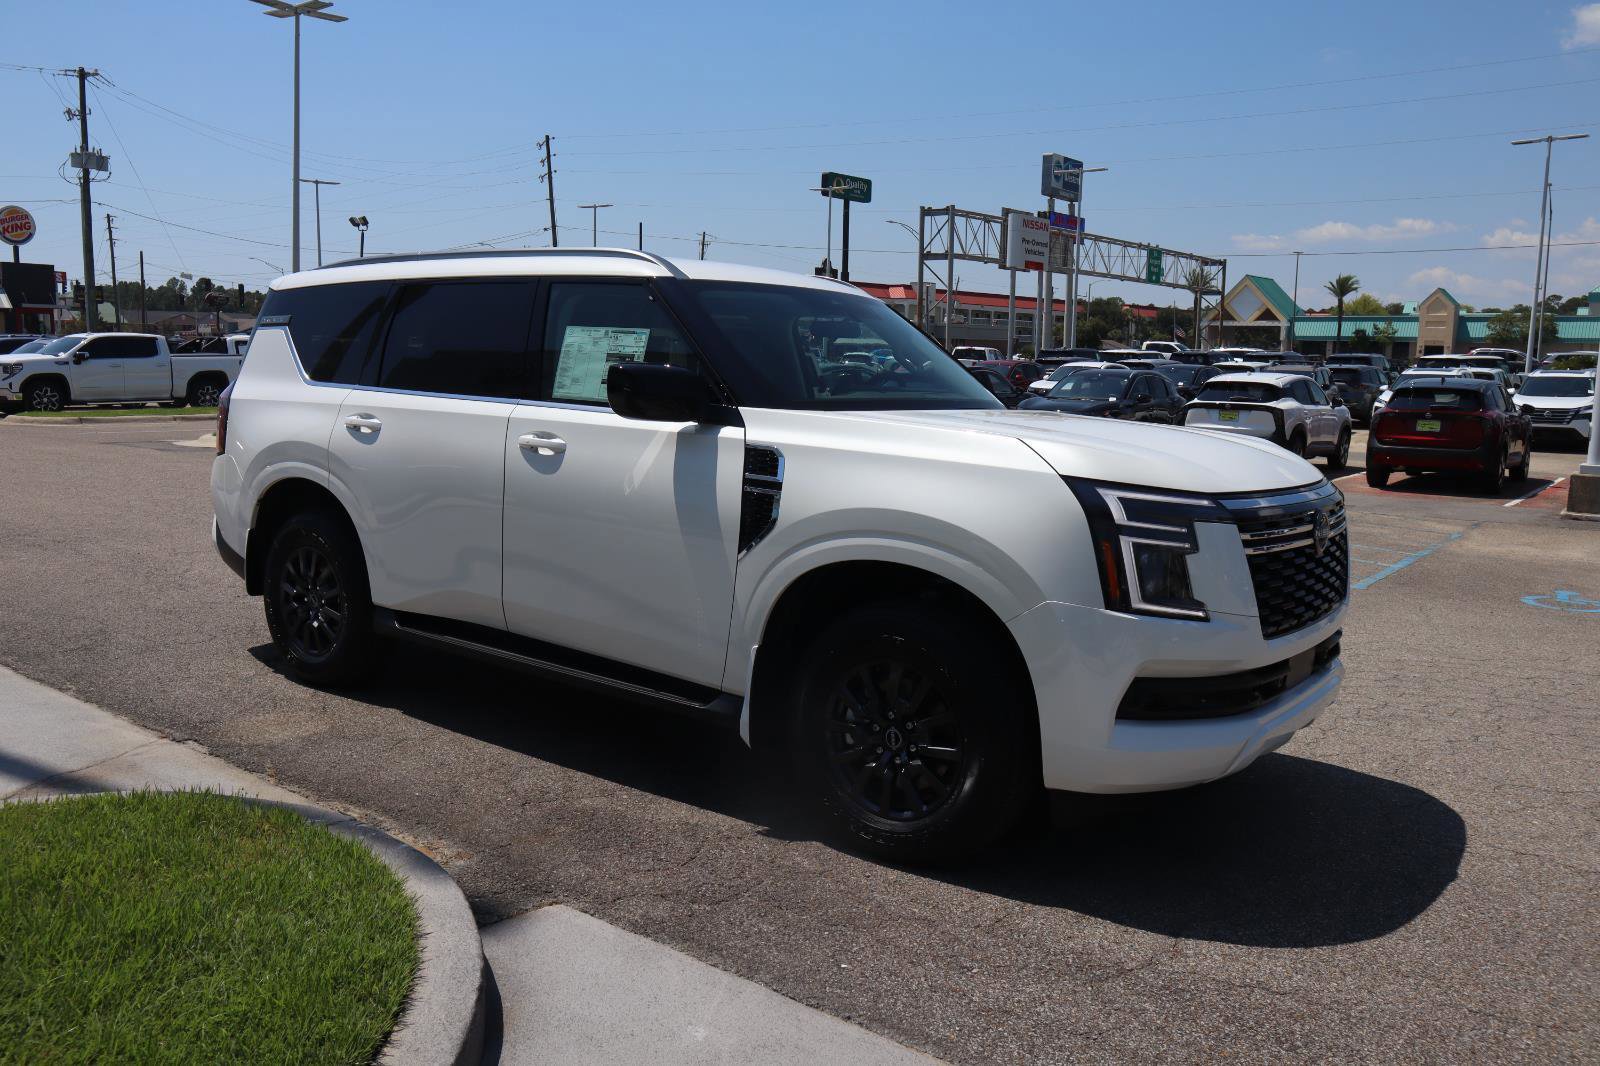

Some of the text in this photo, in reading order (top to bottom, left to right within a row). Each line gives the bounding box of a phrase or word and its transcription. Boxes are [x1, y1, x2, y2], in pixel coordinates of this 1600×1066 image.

[845, 178, 868, 192] Quality
[0, 213, 30, 225] BURGER
[1023, 218, 1049, 232] NISSAN
[2, 221, 32, 235] KING
[1021, 237, 1049, 249] Pre-Owned
[1024, 248, 1046, 257] Vehicles
